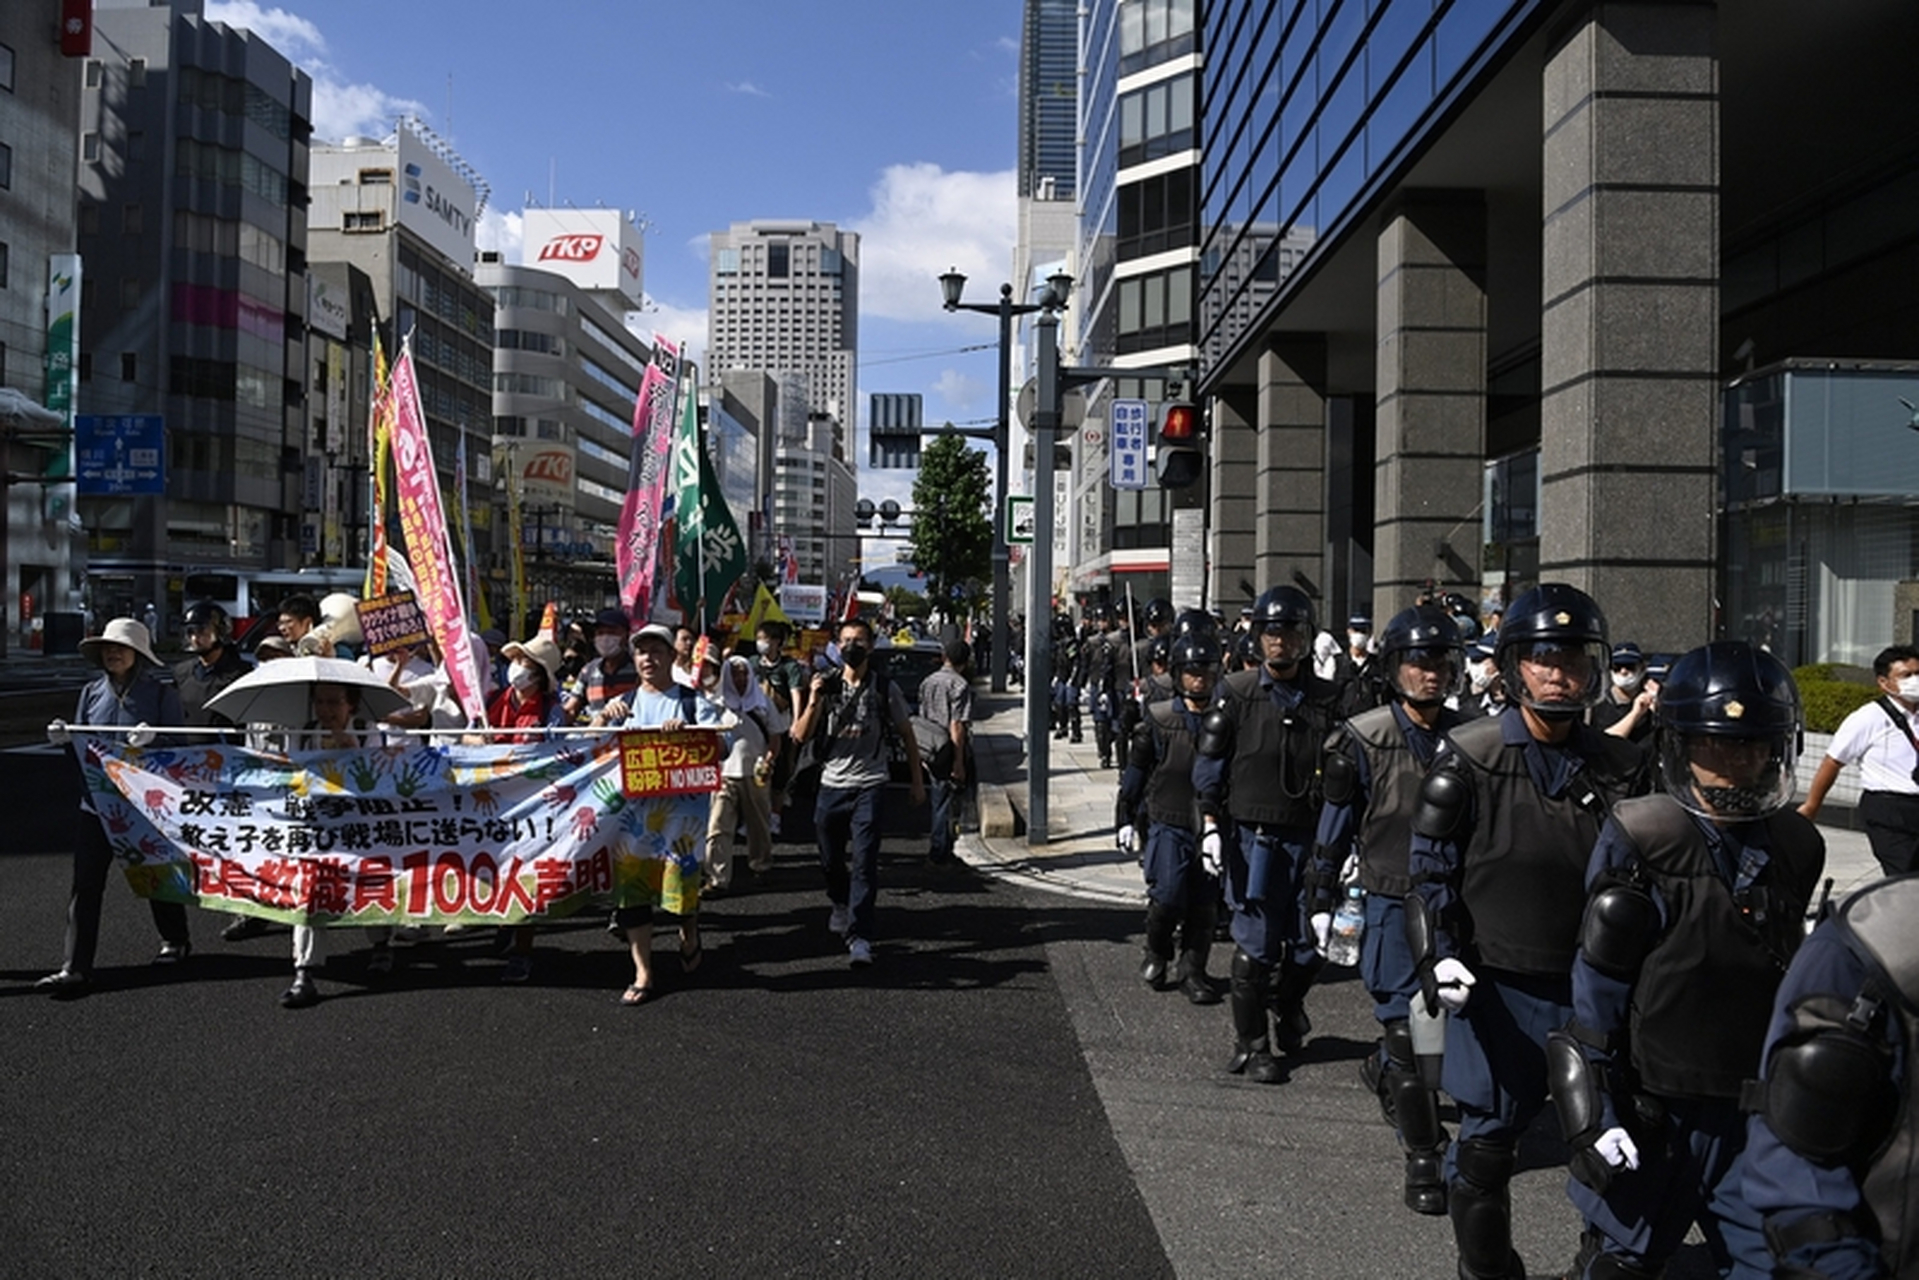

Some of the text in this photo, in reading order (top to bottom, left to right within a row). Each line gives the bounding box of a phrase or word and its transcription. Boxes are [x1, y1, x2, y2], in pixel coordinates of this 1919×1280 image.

[424, 184, 472, 237] SAMTY
[543, 235, 600, 259] TKP
[1115, 406, 1129, 450] 自転車
[1130, 406, 1142, 450] 歩行者
[626, 745, 716, 768] 広島ビジョン
[670, 769, 685, 788] NO
[686, 766, 717, 787] NUKES
